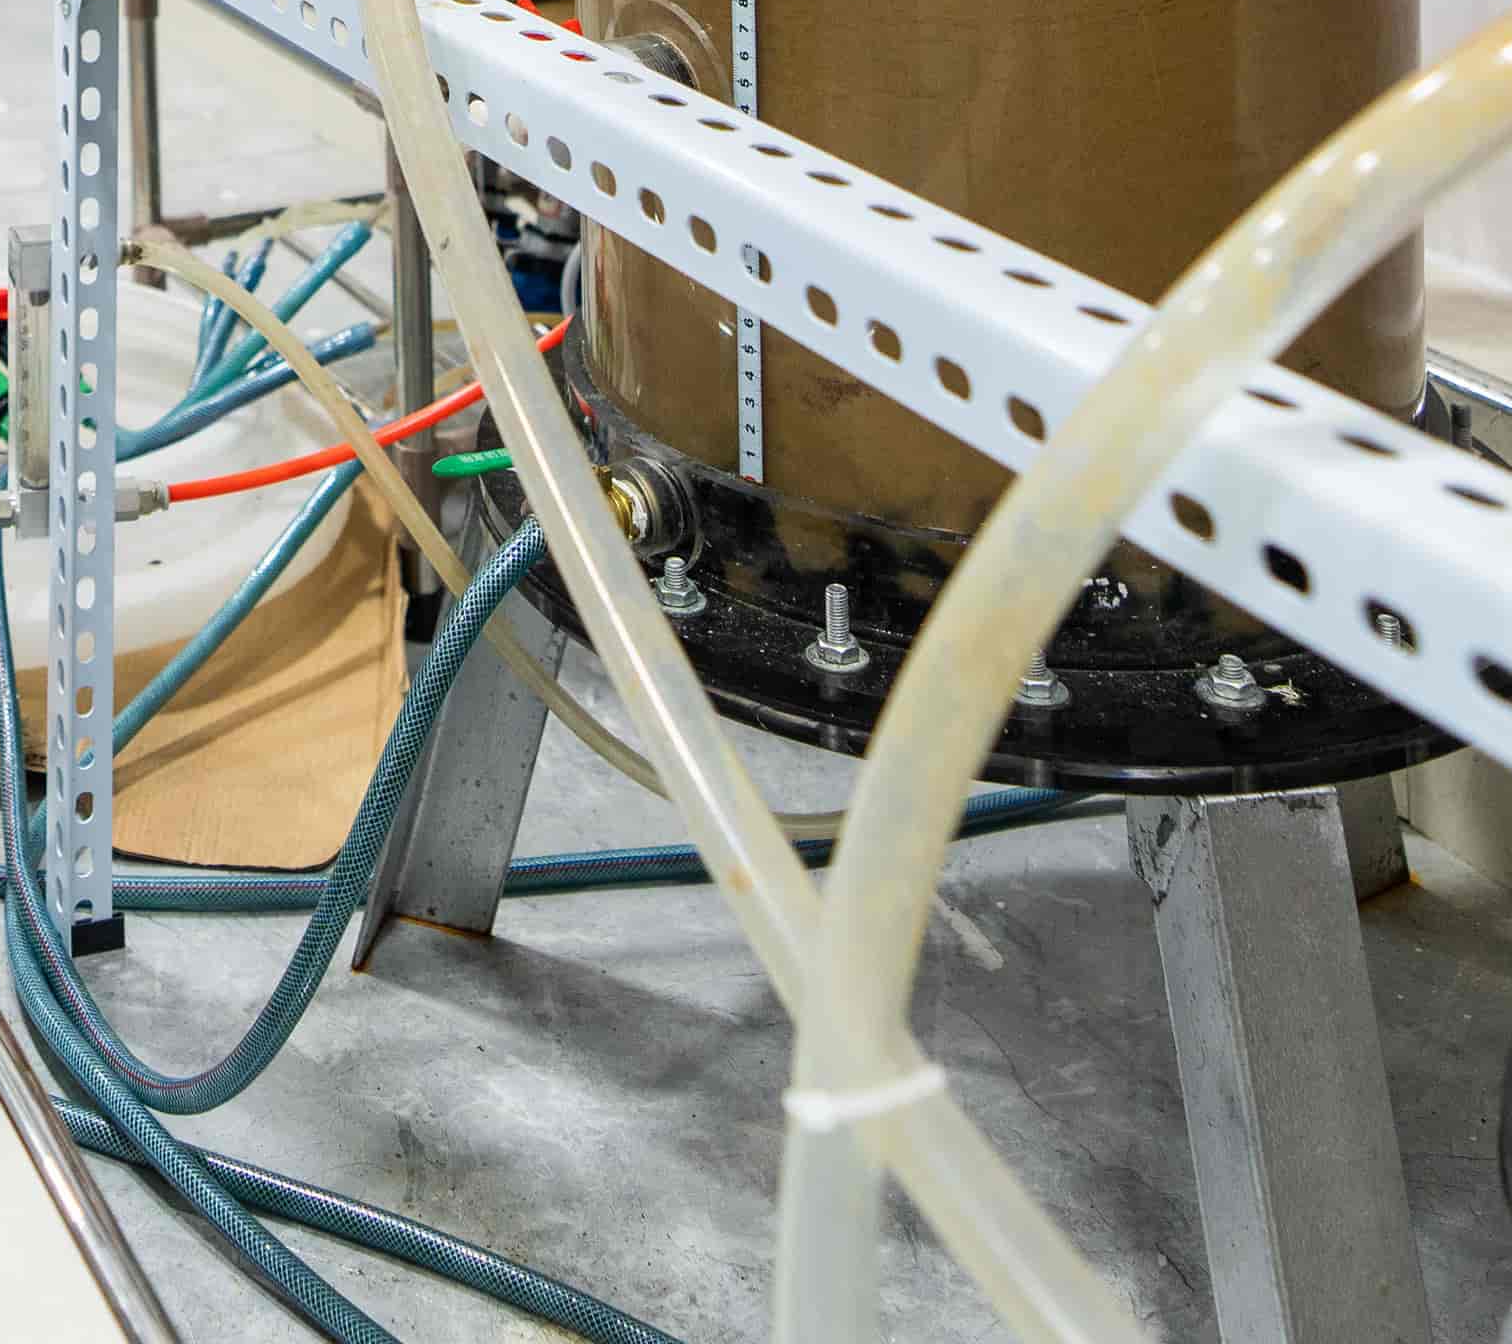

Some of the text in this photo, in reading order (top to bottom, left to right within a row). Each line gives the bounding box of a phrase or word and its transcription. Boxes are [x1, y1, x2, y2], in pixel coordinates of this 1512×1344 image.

[738, 23, 749, 32] 7
[739, 51, 750, 61] 6
[739, 78, 750, 88] 5
[744, 318, 754, 329] 6
[744, 344, 754, 354] 5
[744, 370, 755, 381] 4
[744, 397, 755, 408] 3
[744, 423, 755, 434] 2
